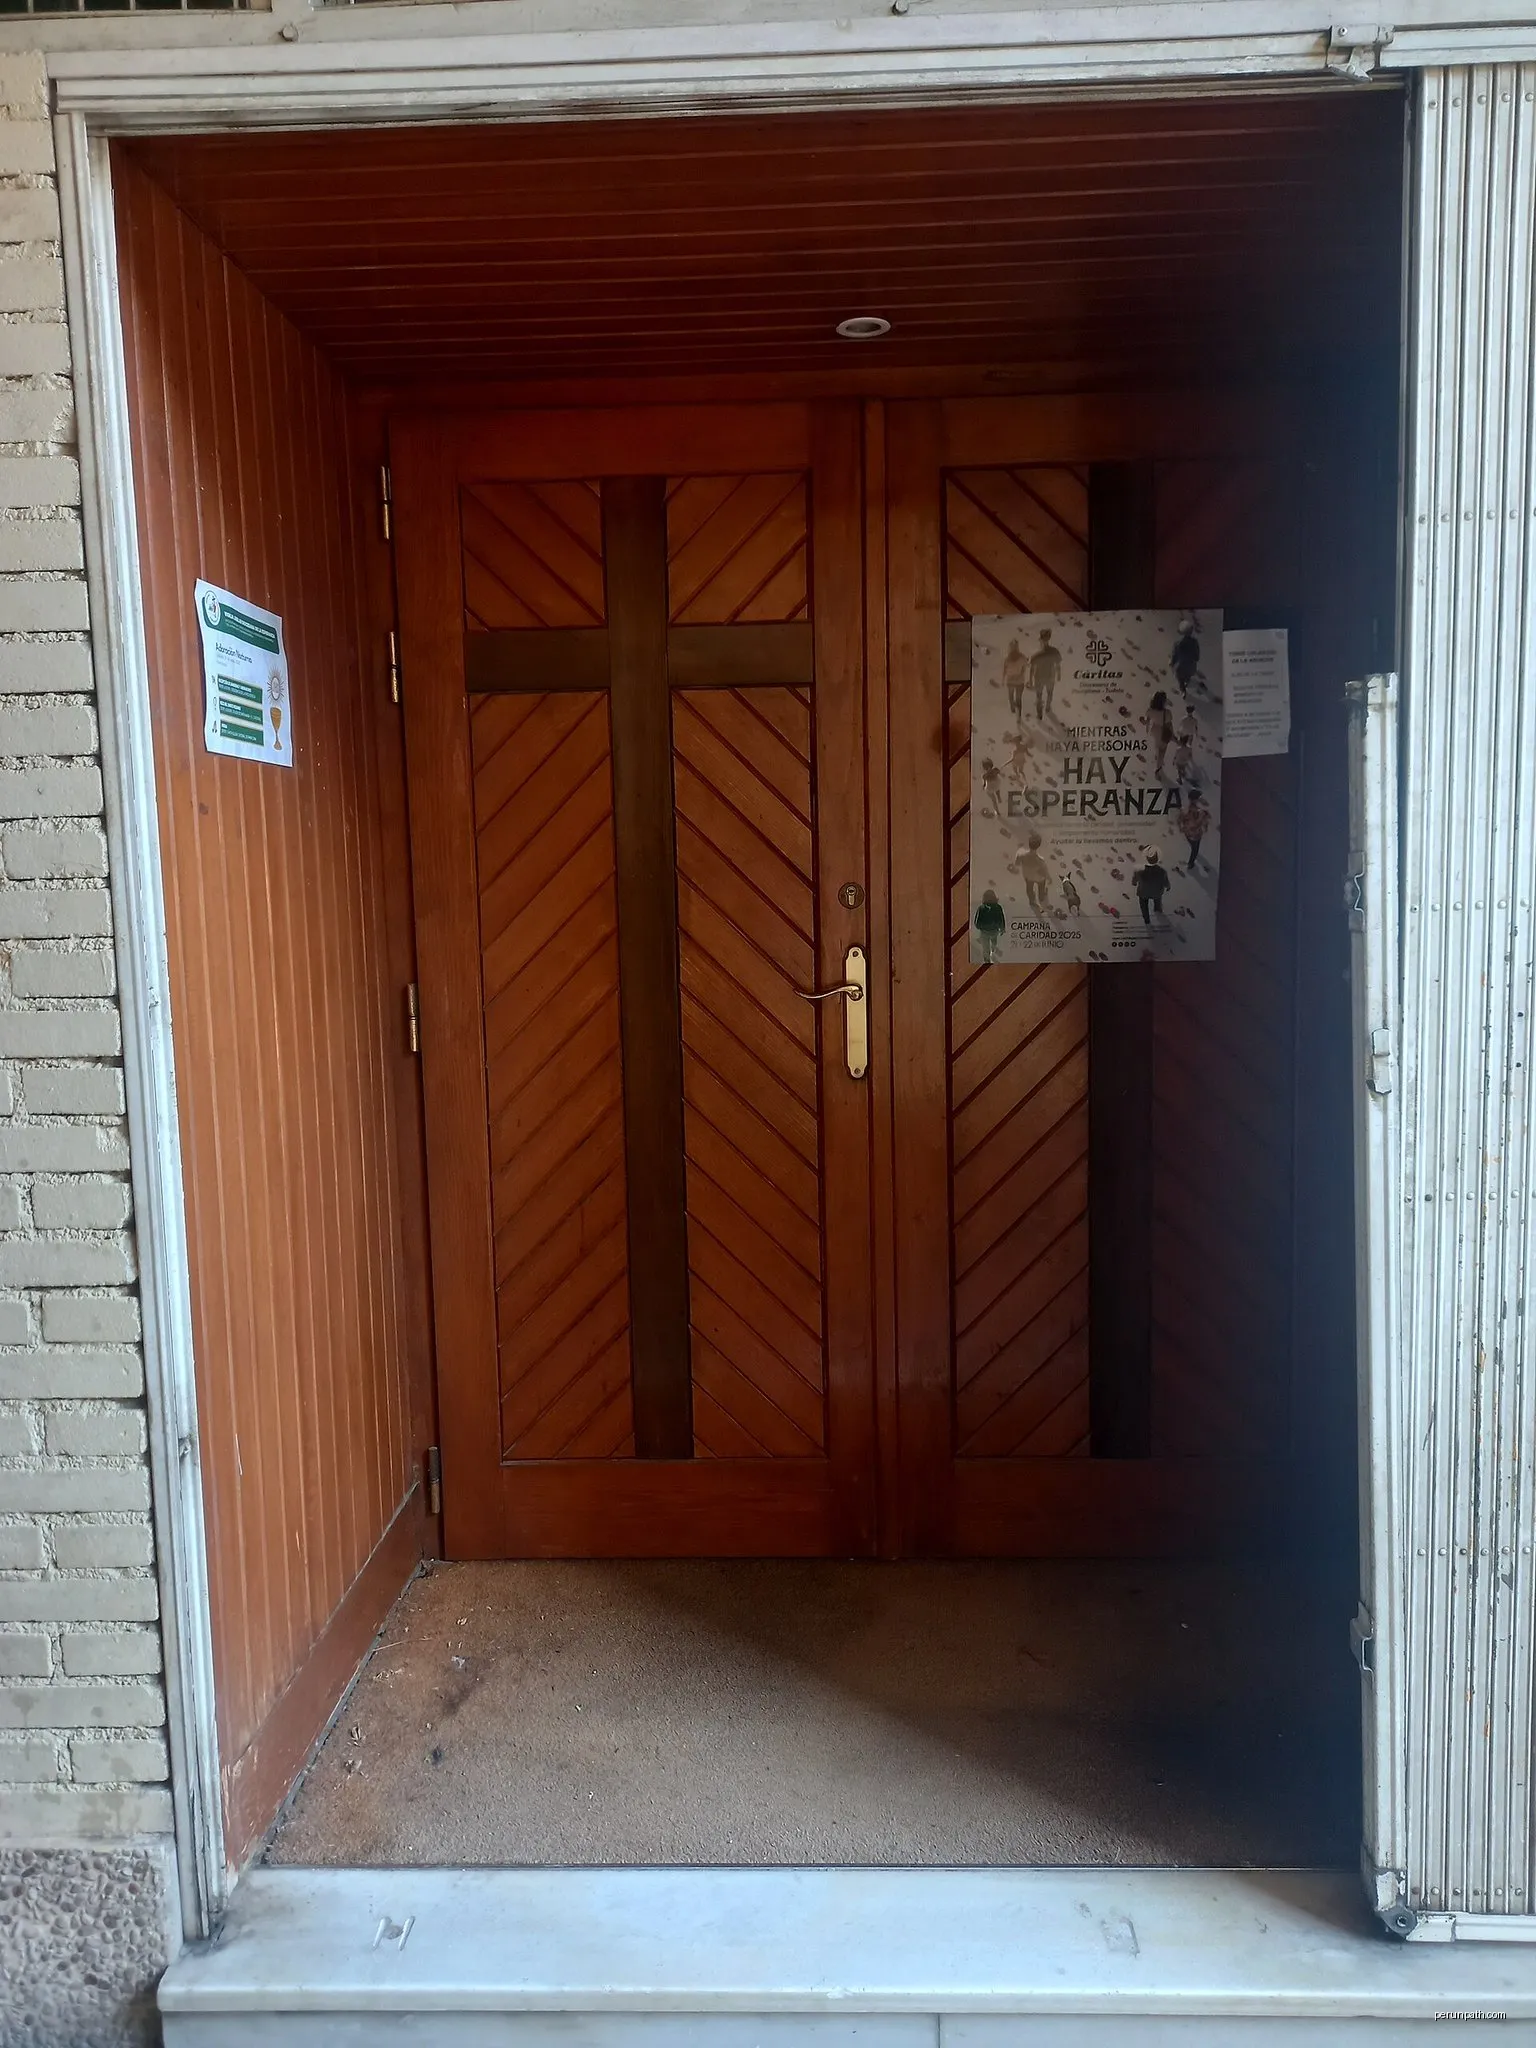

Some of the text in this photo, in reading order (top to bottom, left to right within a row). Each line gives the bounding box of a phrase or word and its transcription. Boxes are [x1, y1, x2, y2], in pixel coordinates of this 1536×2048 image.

[1066, 725, 1127, 738] MIENTRAS
[1046, 739, 1148, 752] HAYA PERSONAS
[1063, 756, 1131, 785] HAY
[1007, 788, 1182, 818] ESPERANZA
[1019, 931, 1058, 940] CARIDAD
[1059, 930, 1082, 939] 2025
[1023, 940, 1033, 949] 22
